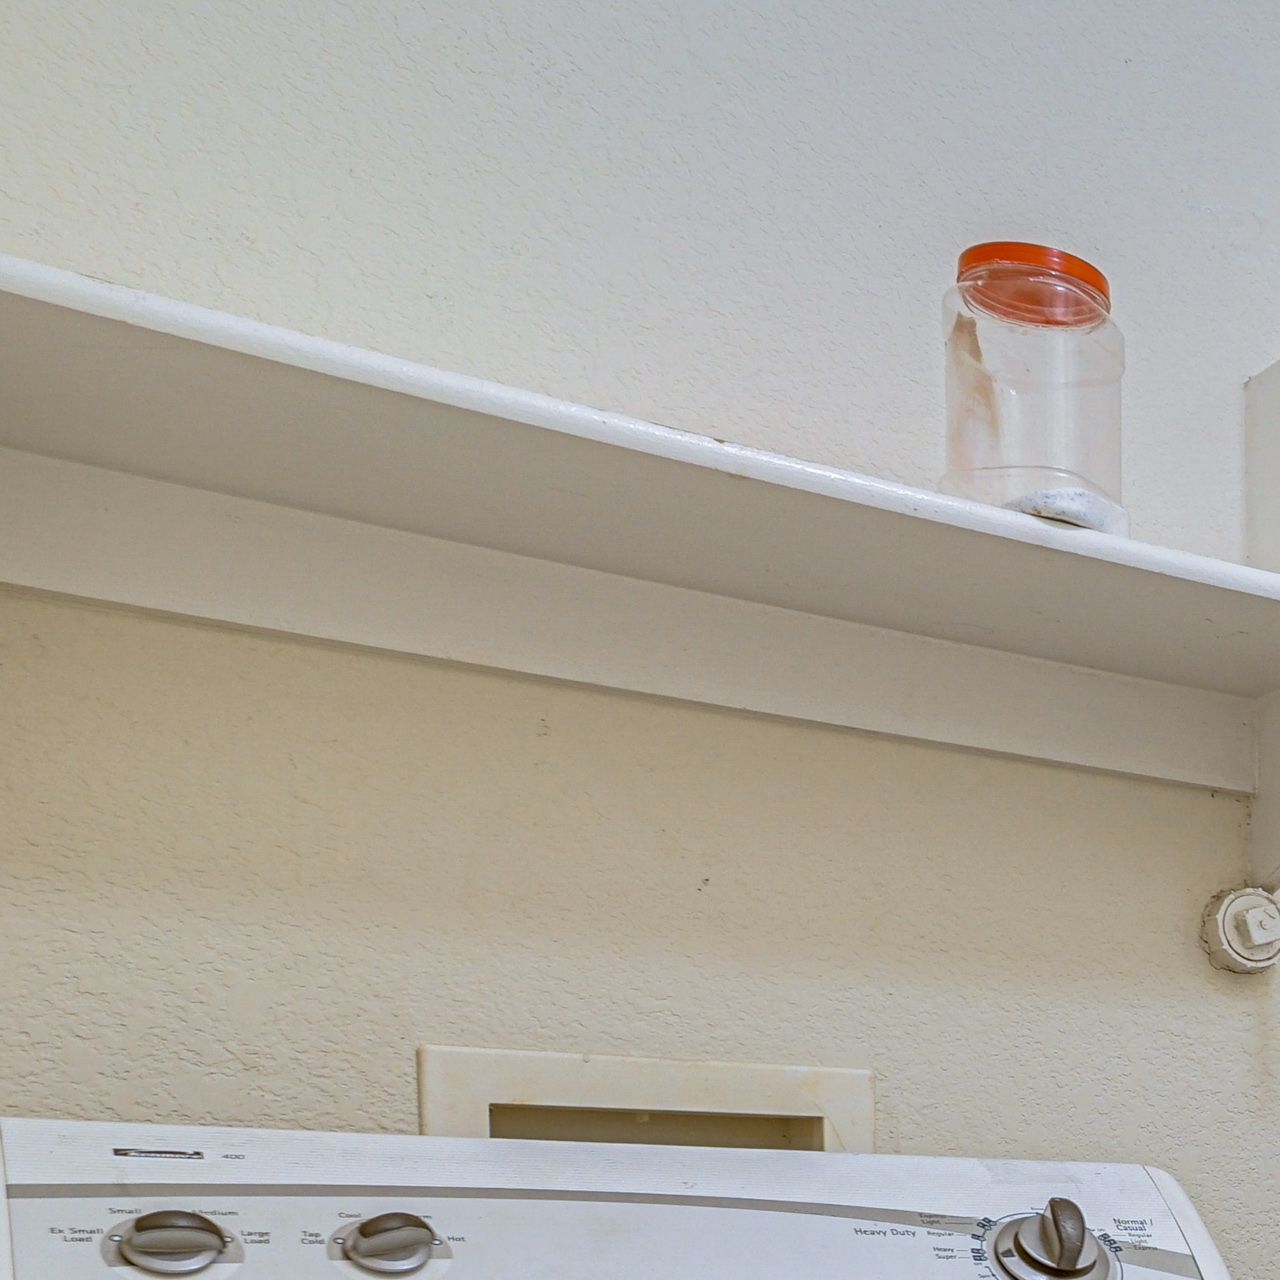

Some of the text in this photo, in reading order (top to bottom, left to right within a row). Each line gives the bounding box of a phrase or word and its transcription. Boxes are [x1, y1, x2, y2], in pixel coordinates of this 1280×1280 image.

[1113, 1217, 1147, 1226] Normal
[68, 1227, 104, 1235] Small
[241, 1230, 271, 1238] Large
[854, 1228, 916, 1237] Heavy Duty
